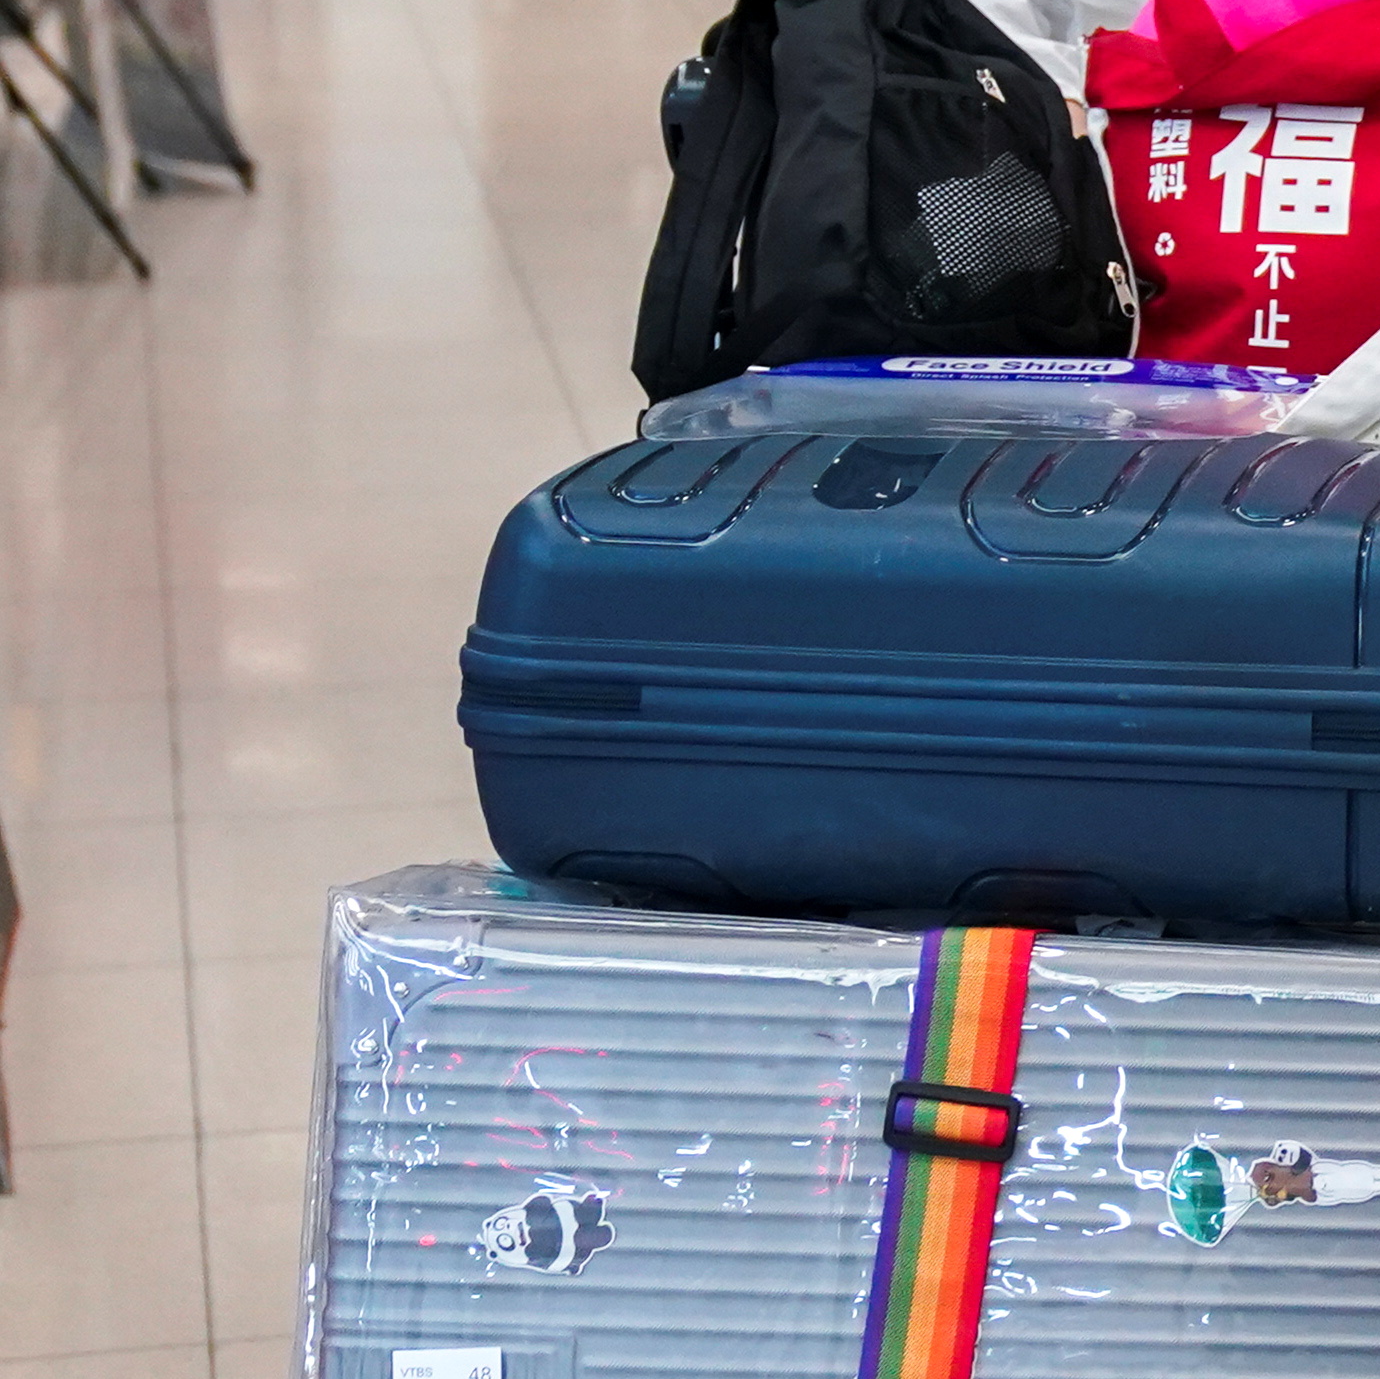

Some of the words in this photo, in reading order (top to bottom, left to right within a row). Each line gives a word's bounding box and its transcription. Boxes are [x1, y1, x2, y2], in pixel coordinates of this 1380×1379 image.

[1148, 108, 1193, 202] 塑料
[1210, 103, 1365, 235] 福
[1247, 243, 1297, 373] 不止
[906, 359, 989, 370] Face
[999, 360, 1113, 372] Shield
[960, 373, 1008, 381] Splash
[1015, 374, 1090, 382] Protection
[400, 1367, 433, 1378] VTBS
